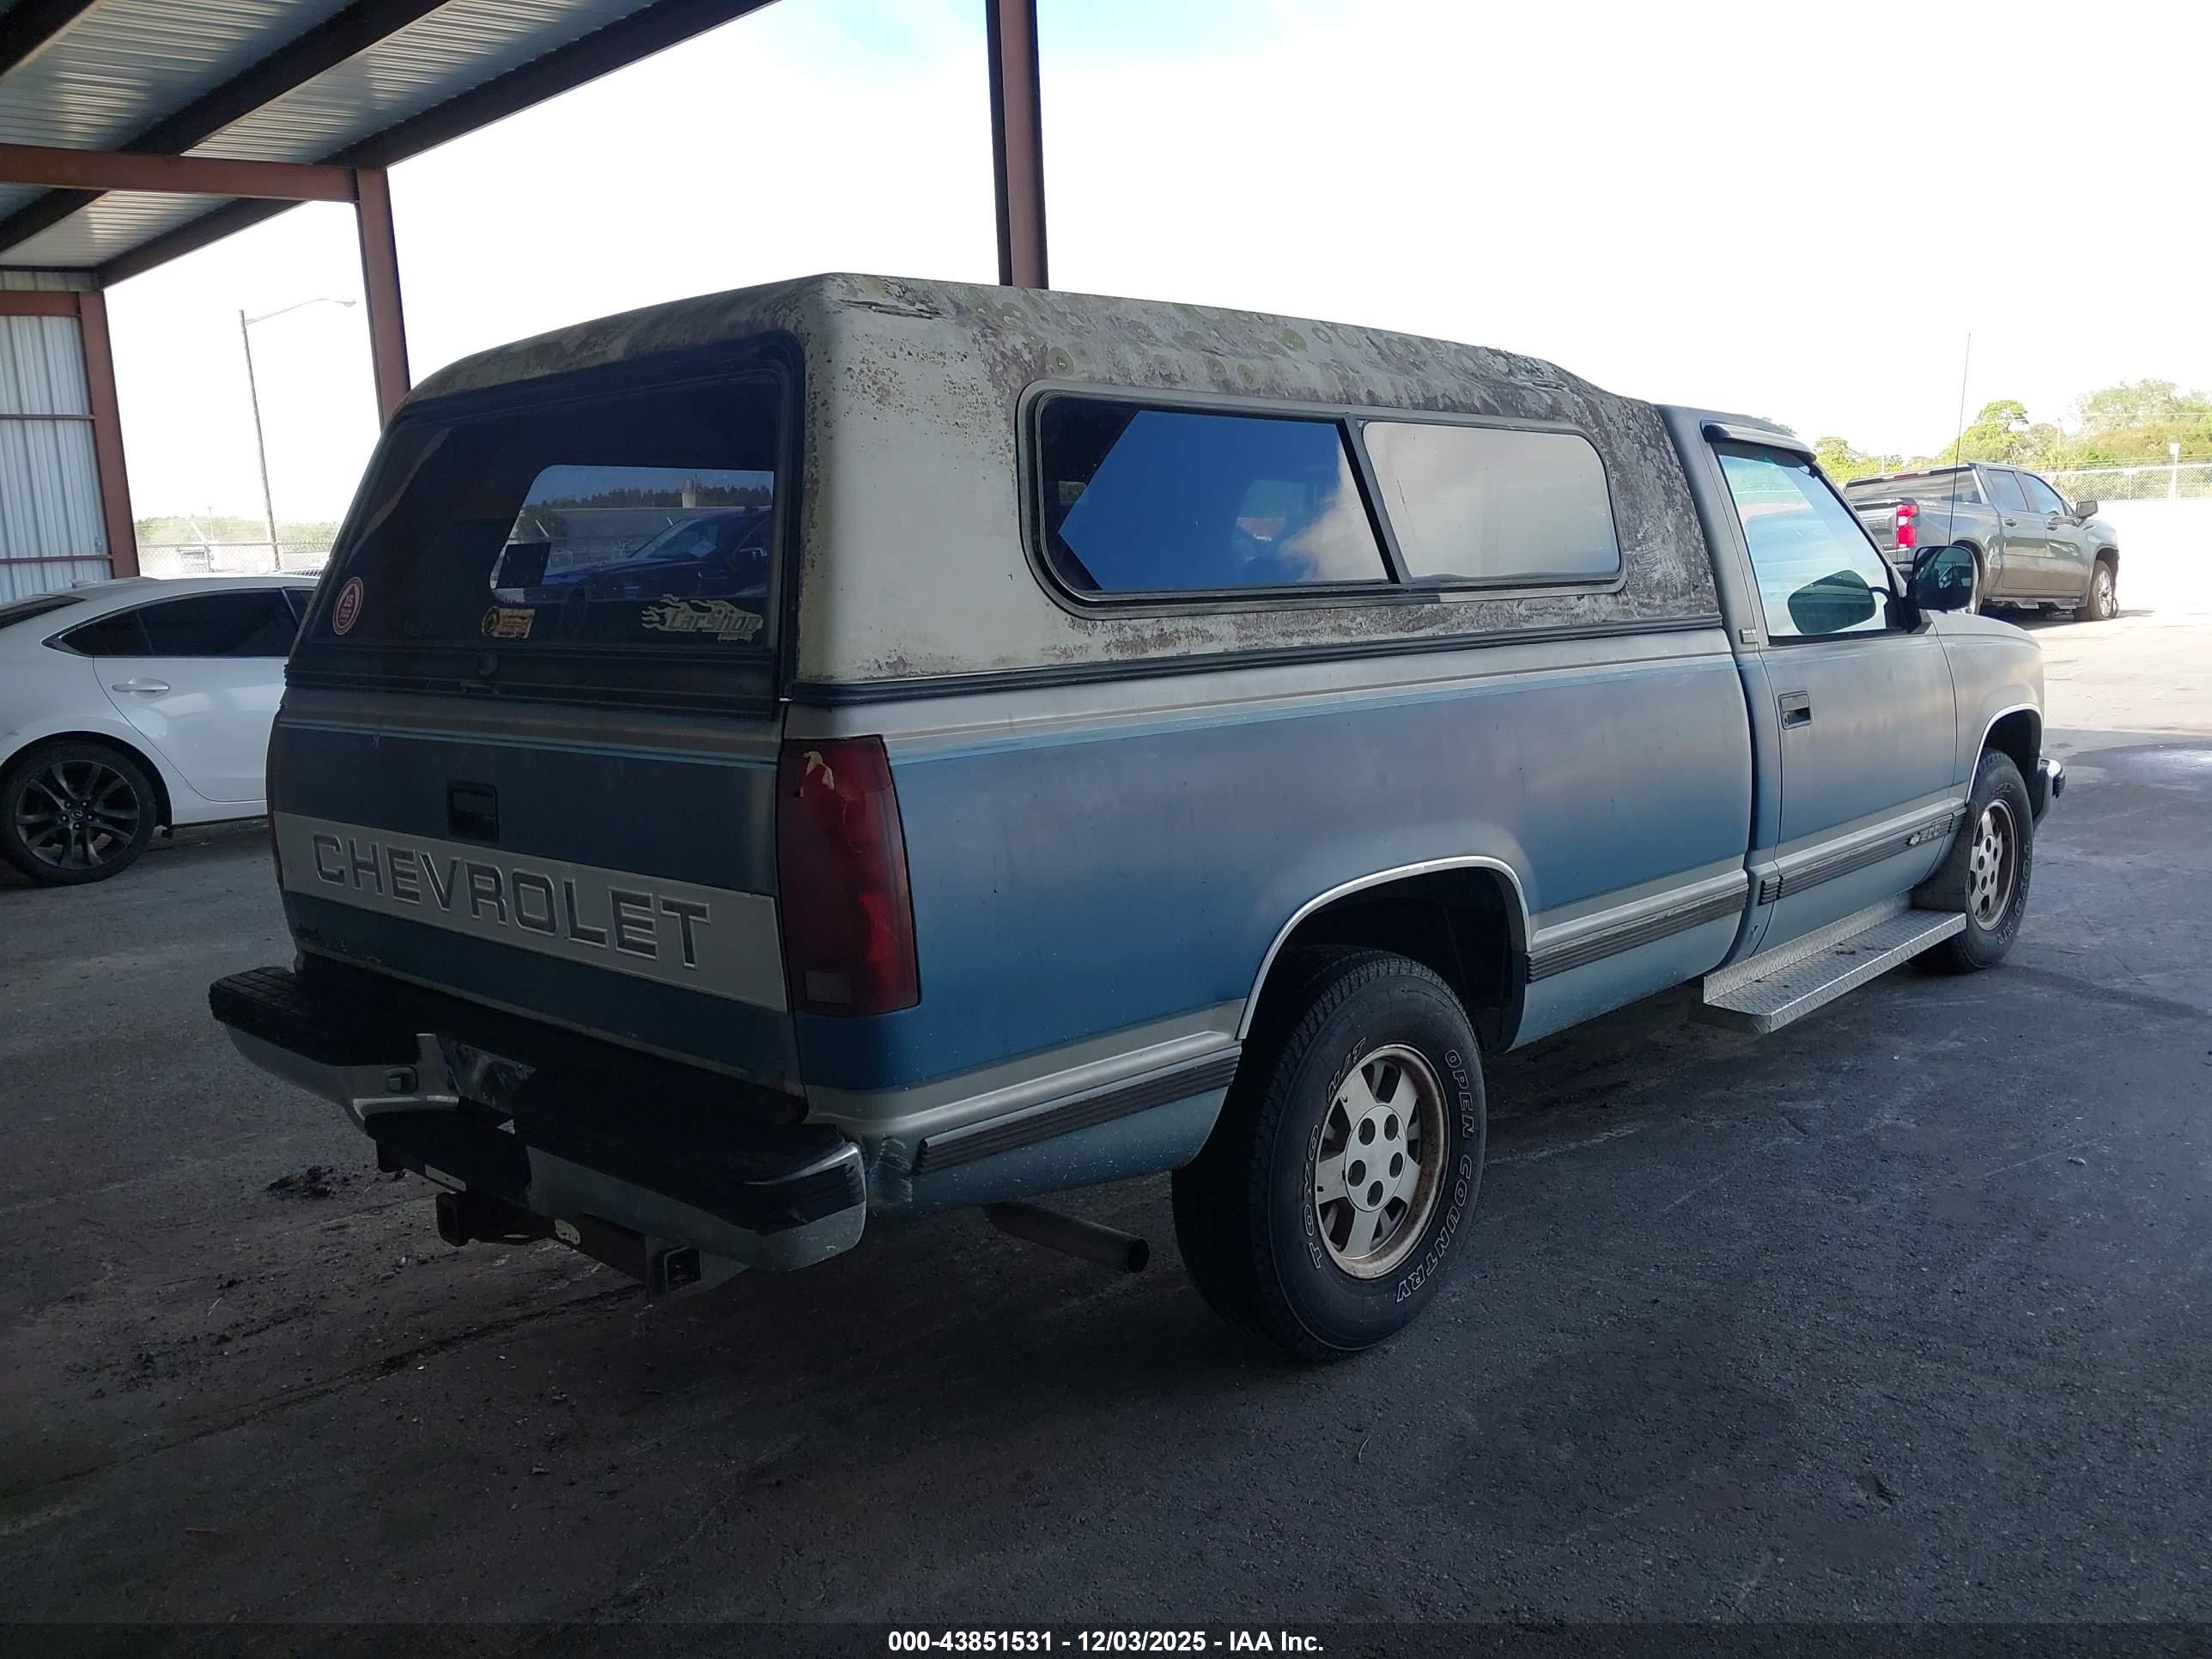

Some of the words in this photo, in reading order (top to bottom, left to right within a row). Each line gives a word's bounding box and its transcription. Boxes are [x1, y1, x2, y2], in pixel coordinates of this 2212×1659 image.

[313, 832, 712, 969] CHEVROLET
[2014, 840, 2032, 917] TOYO
[1444, 1048, 1475, 1140] OPEN
[1302, 1123, 1319, 1270] TOYO
[1396, 1154, 1473, 1304] COUNTRY
